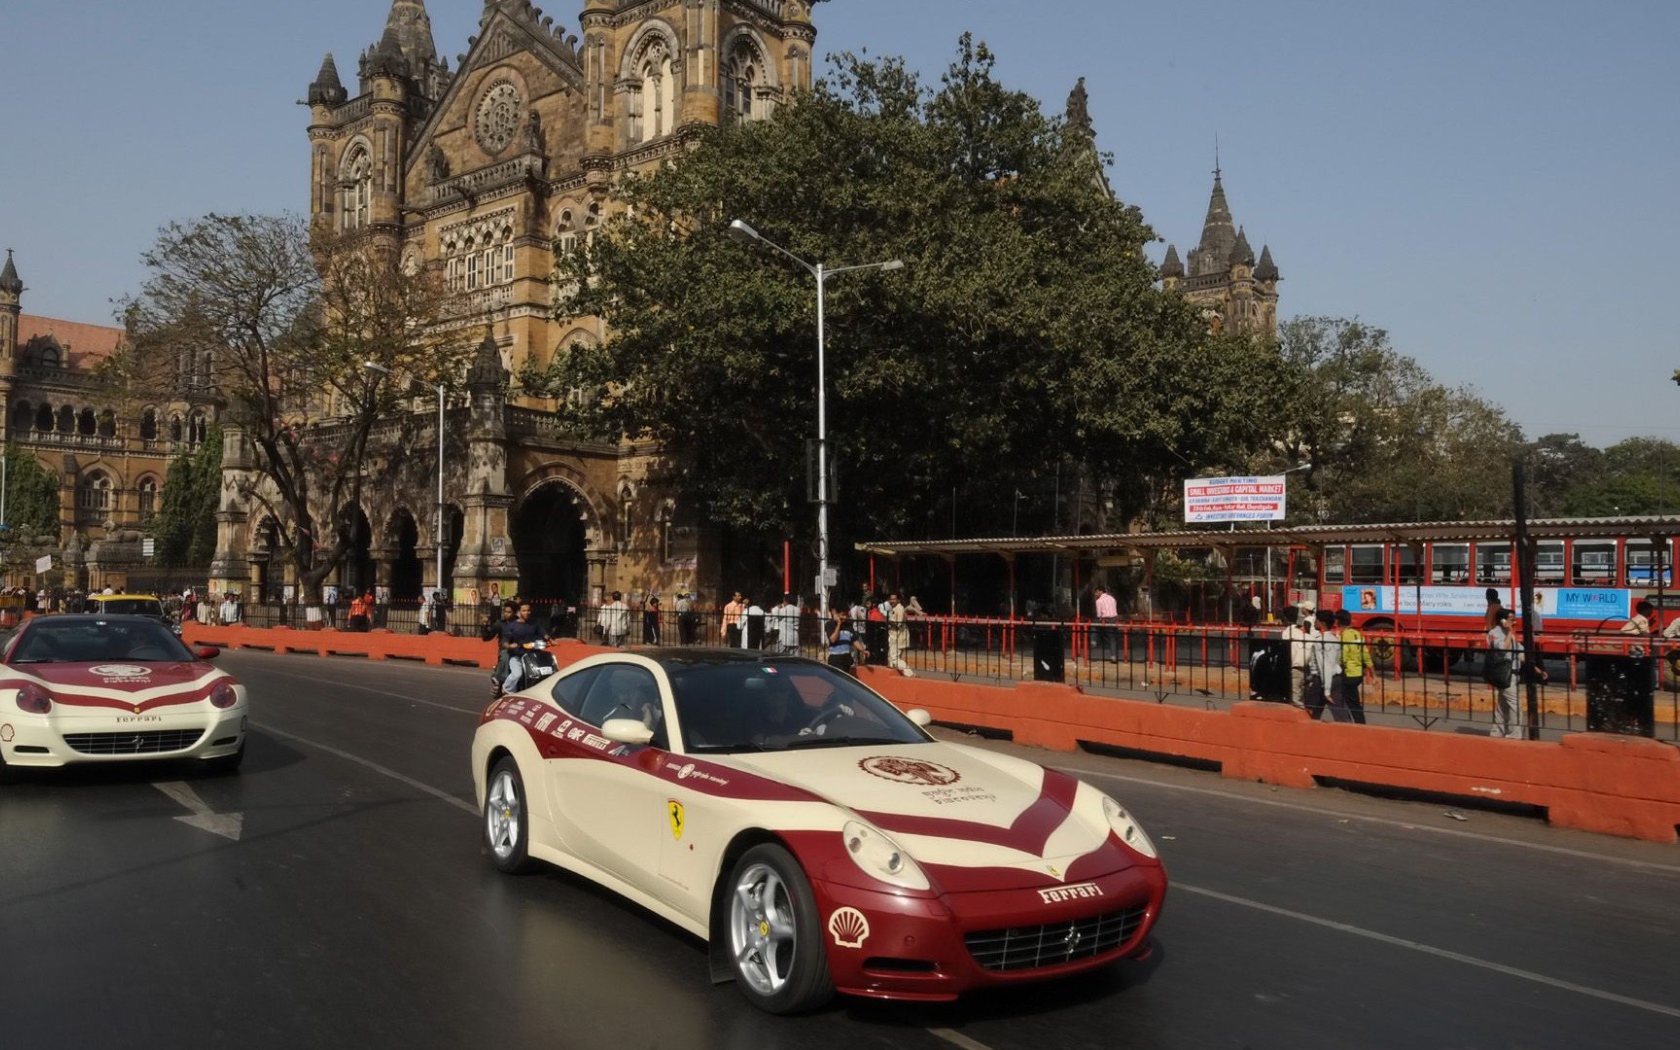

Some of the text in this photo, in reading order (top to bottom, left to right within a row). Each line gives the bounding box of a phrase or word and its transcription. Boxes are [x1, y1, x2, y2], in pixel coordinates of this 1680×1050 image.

[1189, 487, 1206, 496] SMALL
[1234, 485, 1258, 494] CAPITAL
[1259, 484, 1282, 494] MARKET
[1566, 593, 1579, 602] MY
[116, 715, 162, 723] Ferrari
[1037, 882, 1104, 905] Ferrari
